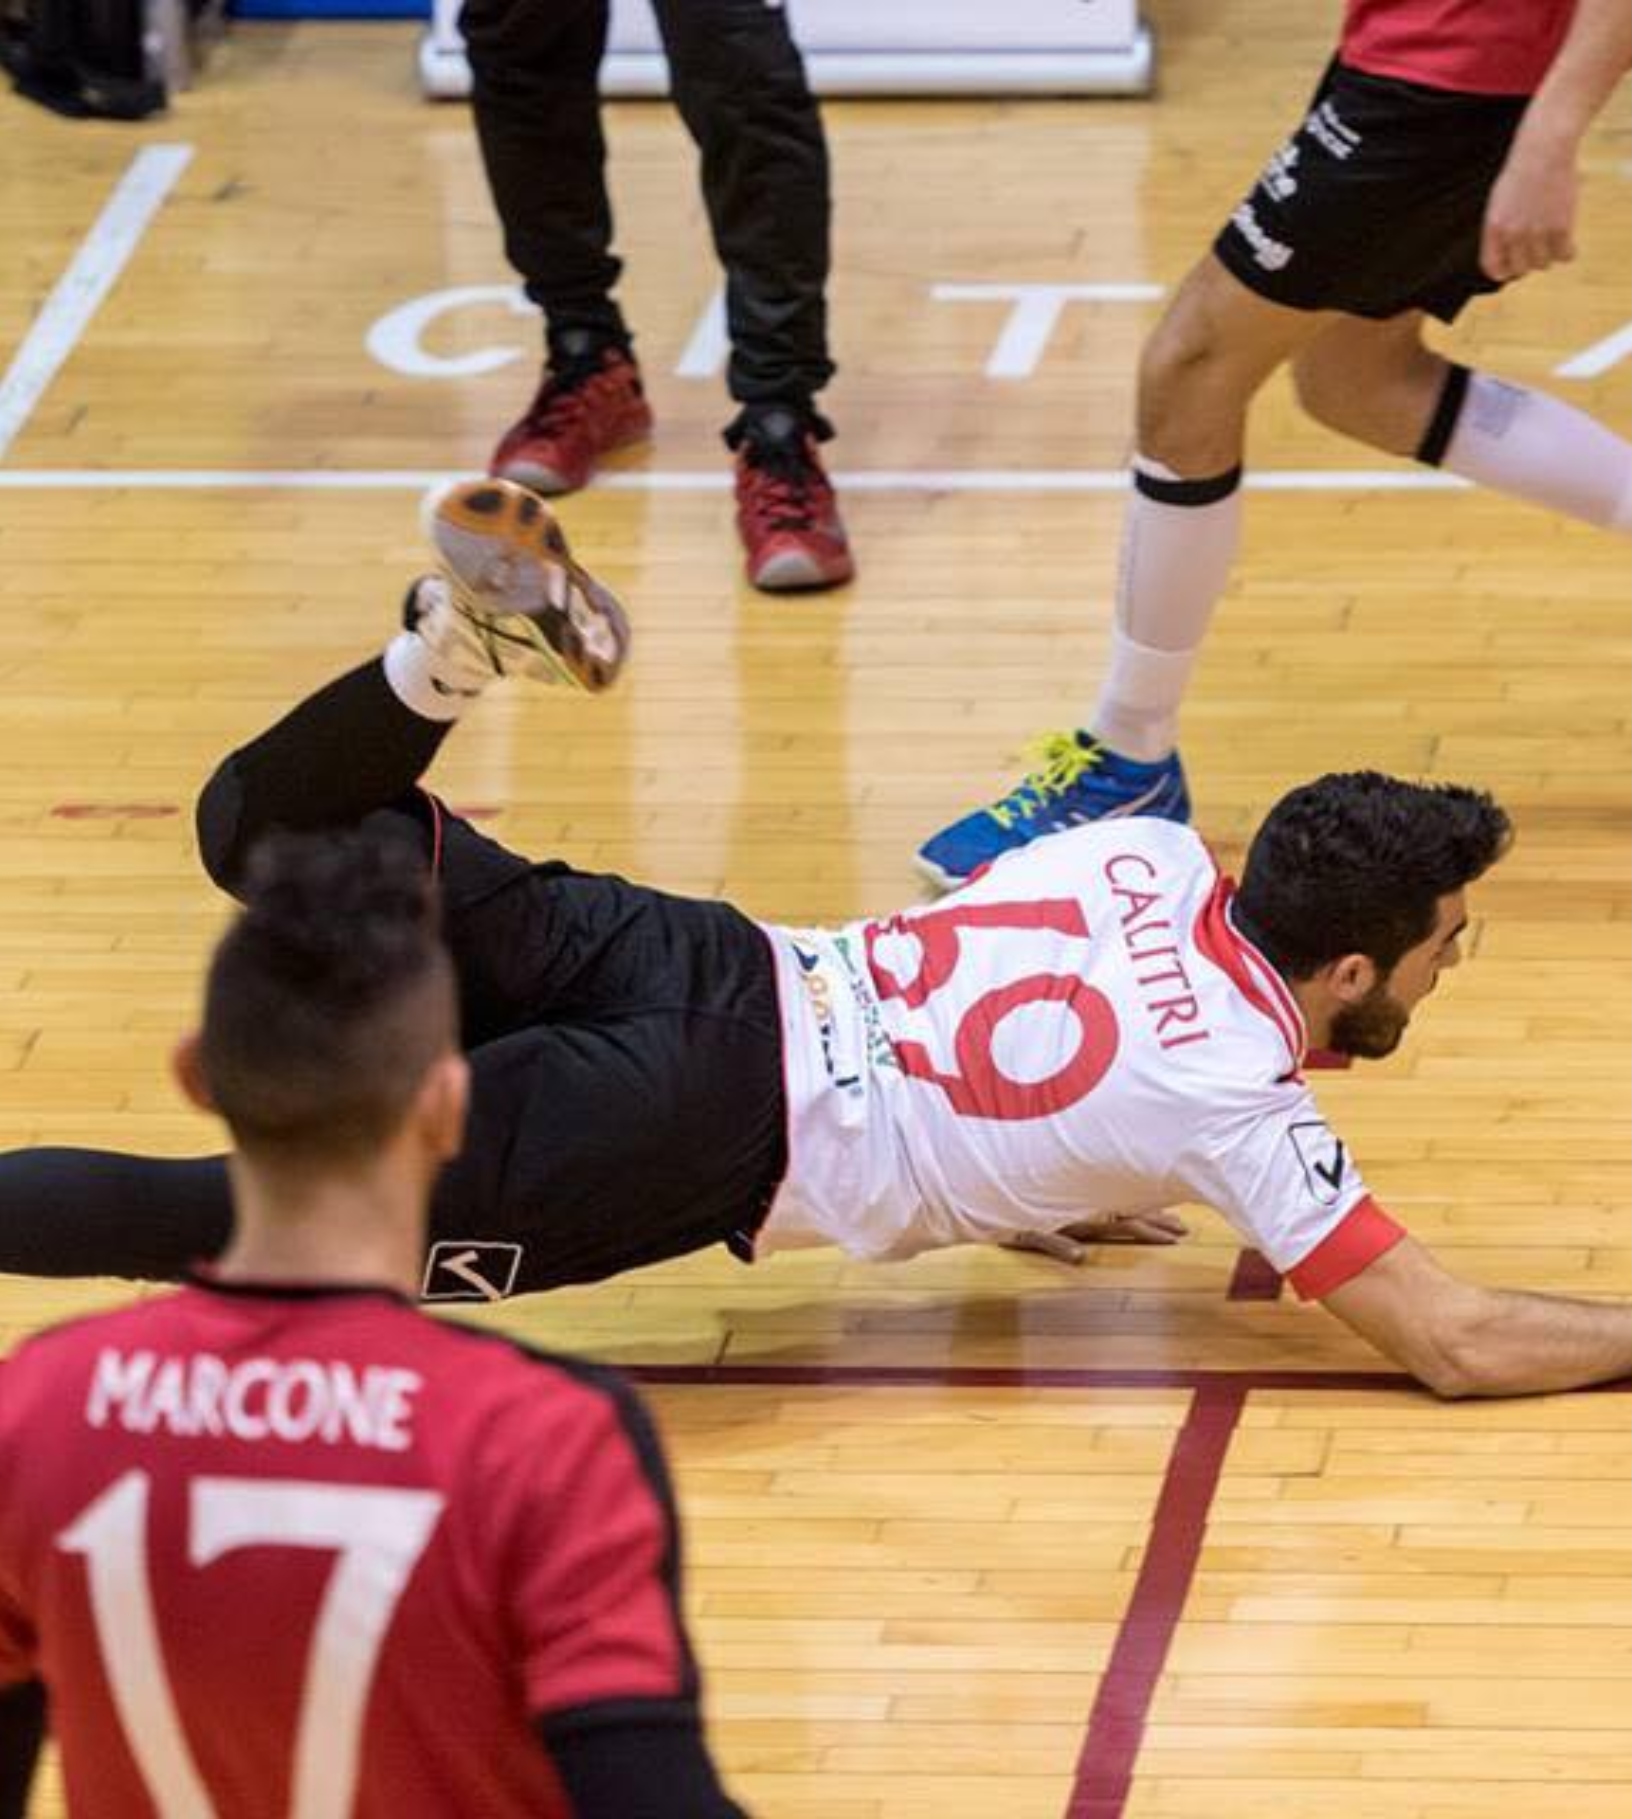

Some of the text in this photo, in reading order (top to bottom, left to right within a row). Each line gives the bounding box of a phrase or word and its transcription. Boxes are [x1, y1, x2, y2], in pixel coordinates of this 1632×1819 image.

[864, 897, 1120, 1121] 69
[1104, 853, 1210, 1051] CALITRI
[86, 1348, 424, 1451] MARCONE
[56, 1468, 446, 1819] 17
